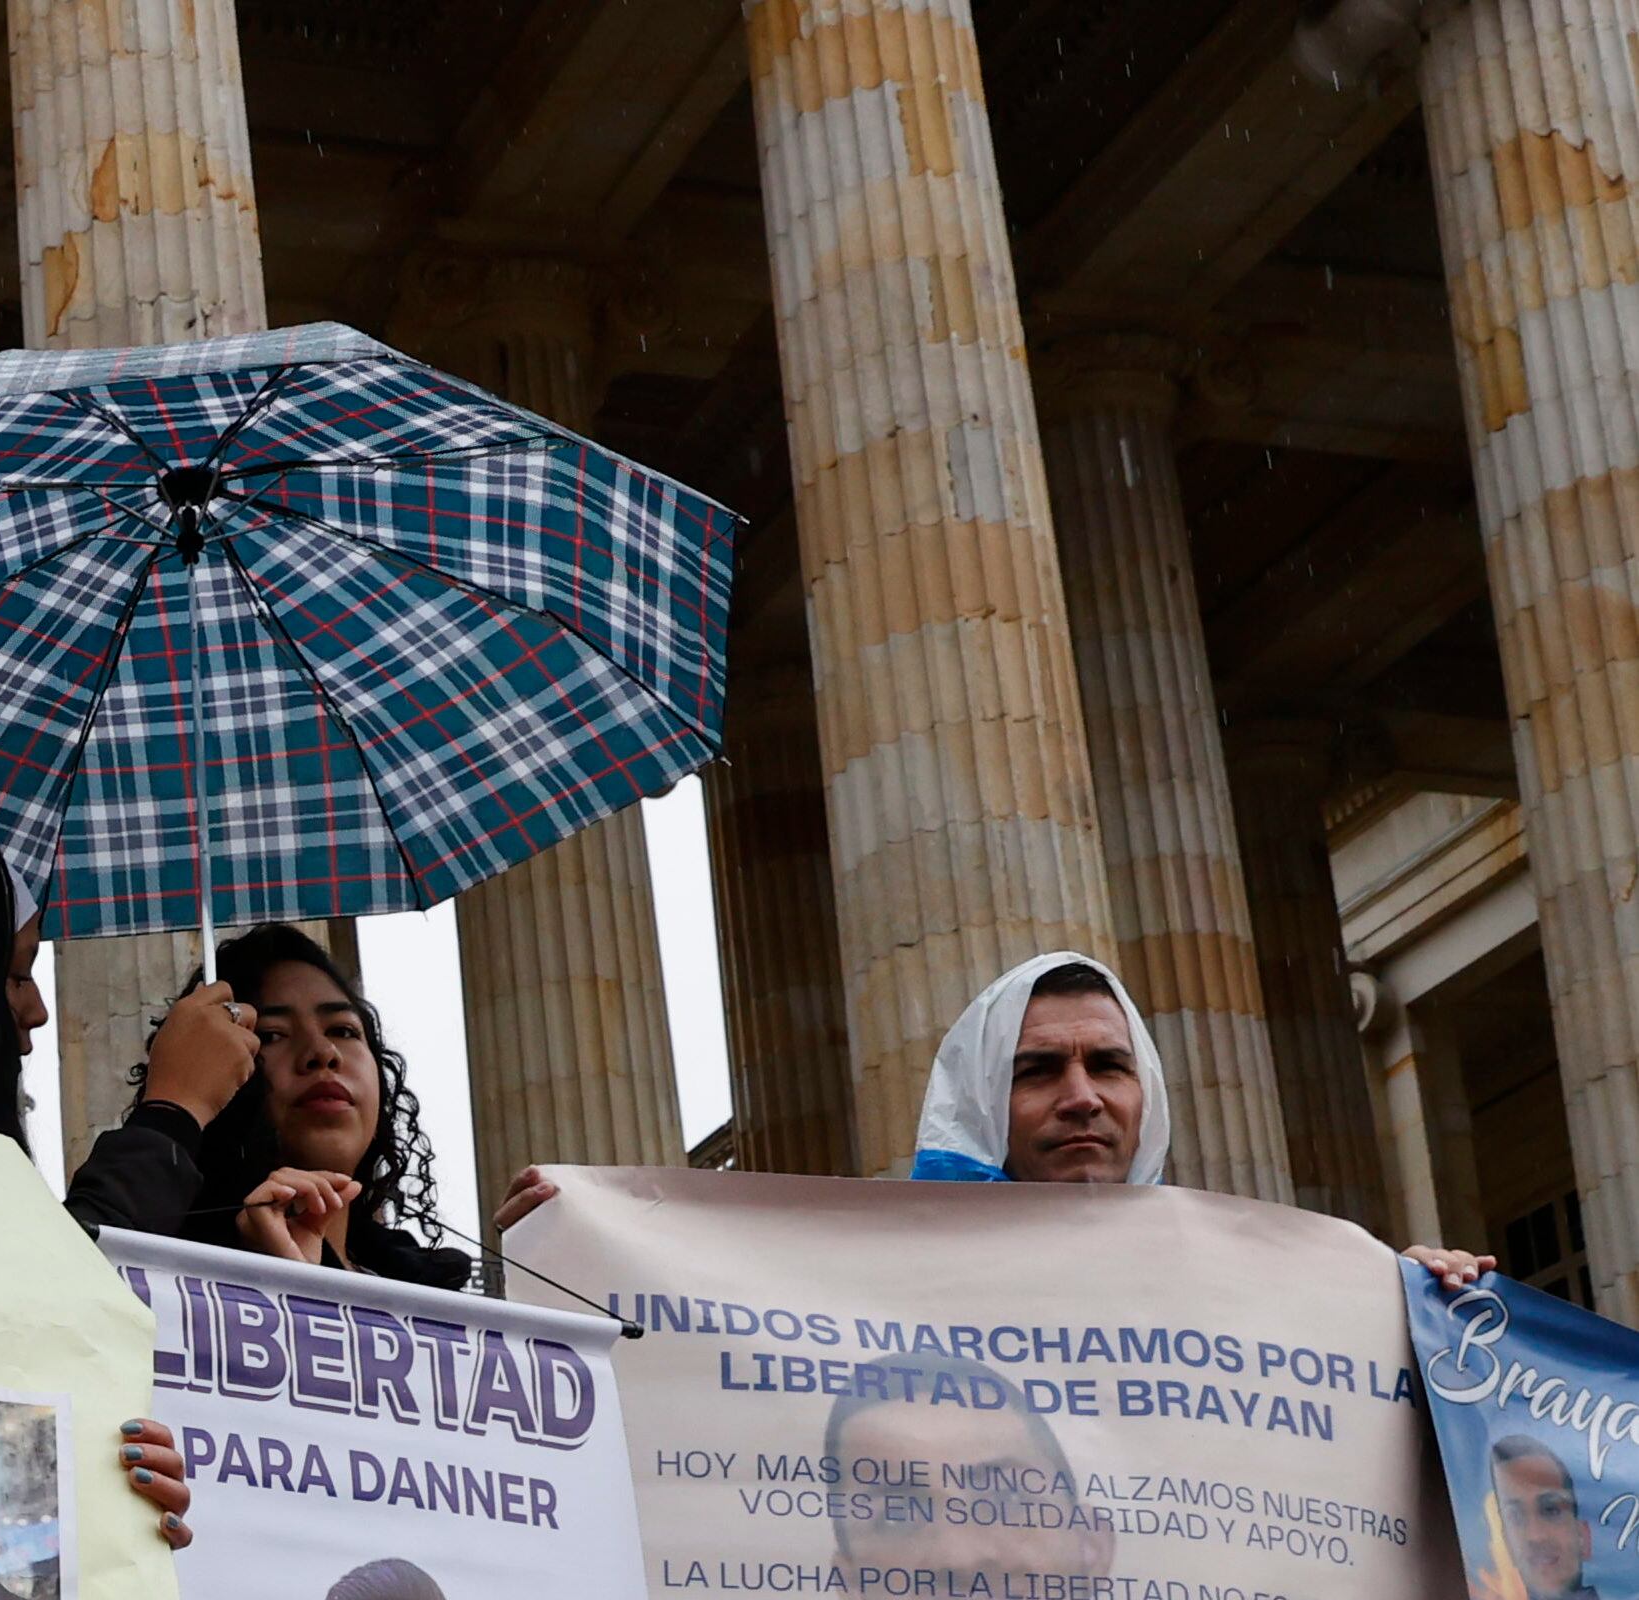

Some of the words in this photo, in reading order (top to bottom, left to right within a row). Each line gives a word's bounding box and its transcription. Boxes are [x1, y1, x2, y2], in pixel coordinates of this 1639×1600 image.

[609, 1294, 841, 1345] UNIDOS
[855, 1319, 1244, 1373] MARCHAMOS
[1257, 1342, 1355, 1392] POR
[1369, 1361, 1417, 1408] LA
[721, 1352, 1006, 1411] LIBERTAD
[1024, 1379, 1100, 1416] DE
[1118, 1380, 1333, 1441] BRAYAN
[182, 1426, 336, 1498] PARA
[348, 1450, 560, 1530] DANNER
[657, 1450, 736, 1479] HOY
[757, 1454, 841, 1484] MAS
[852, 1458, 930, 1488] QUE
[942, 1463, 1075, 1496] NUNCA
[1085, 1473, 1254, 1513] ALZAMOS
[1263, 1491, 1408, 1546] NUESTRAS
[739, 1489, 874, 1520] VOCES
[884, 1496, 934, 1523] EN
[945, 1497, 1208, 1540] SOLIDARIDAD
[1217, 1517, 1235, 1543] Y
[1246, 1523, 1354, 1566] APOYO.
[663, 1560, 709, 1588] LA
[721, 1562, 848, 1593] LUCHA
[860, 1567, 937, 1596] POR
[948, 1570, 994, 1599] LA
